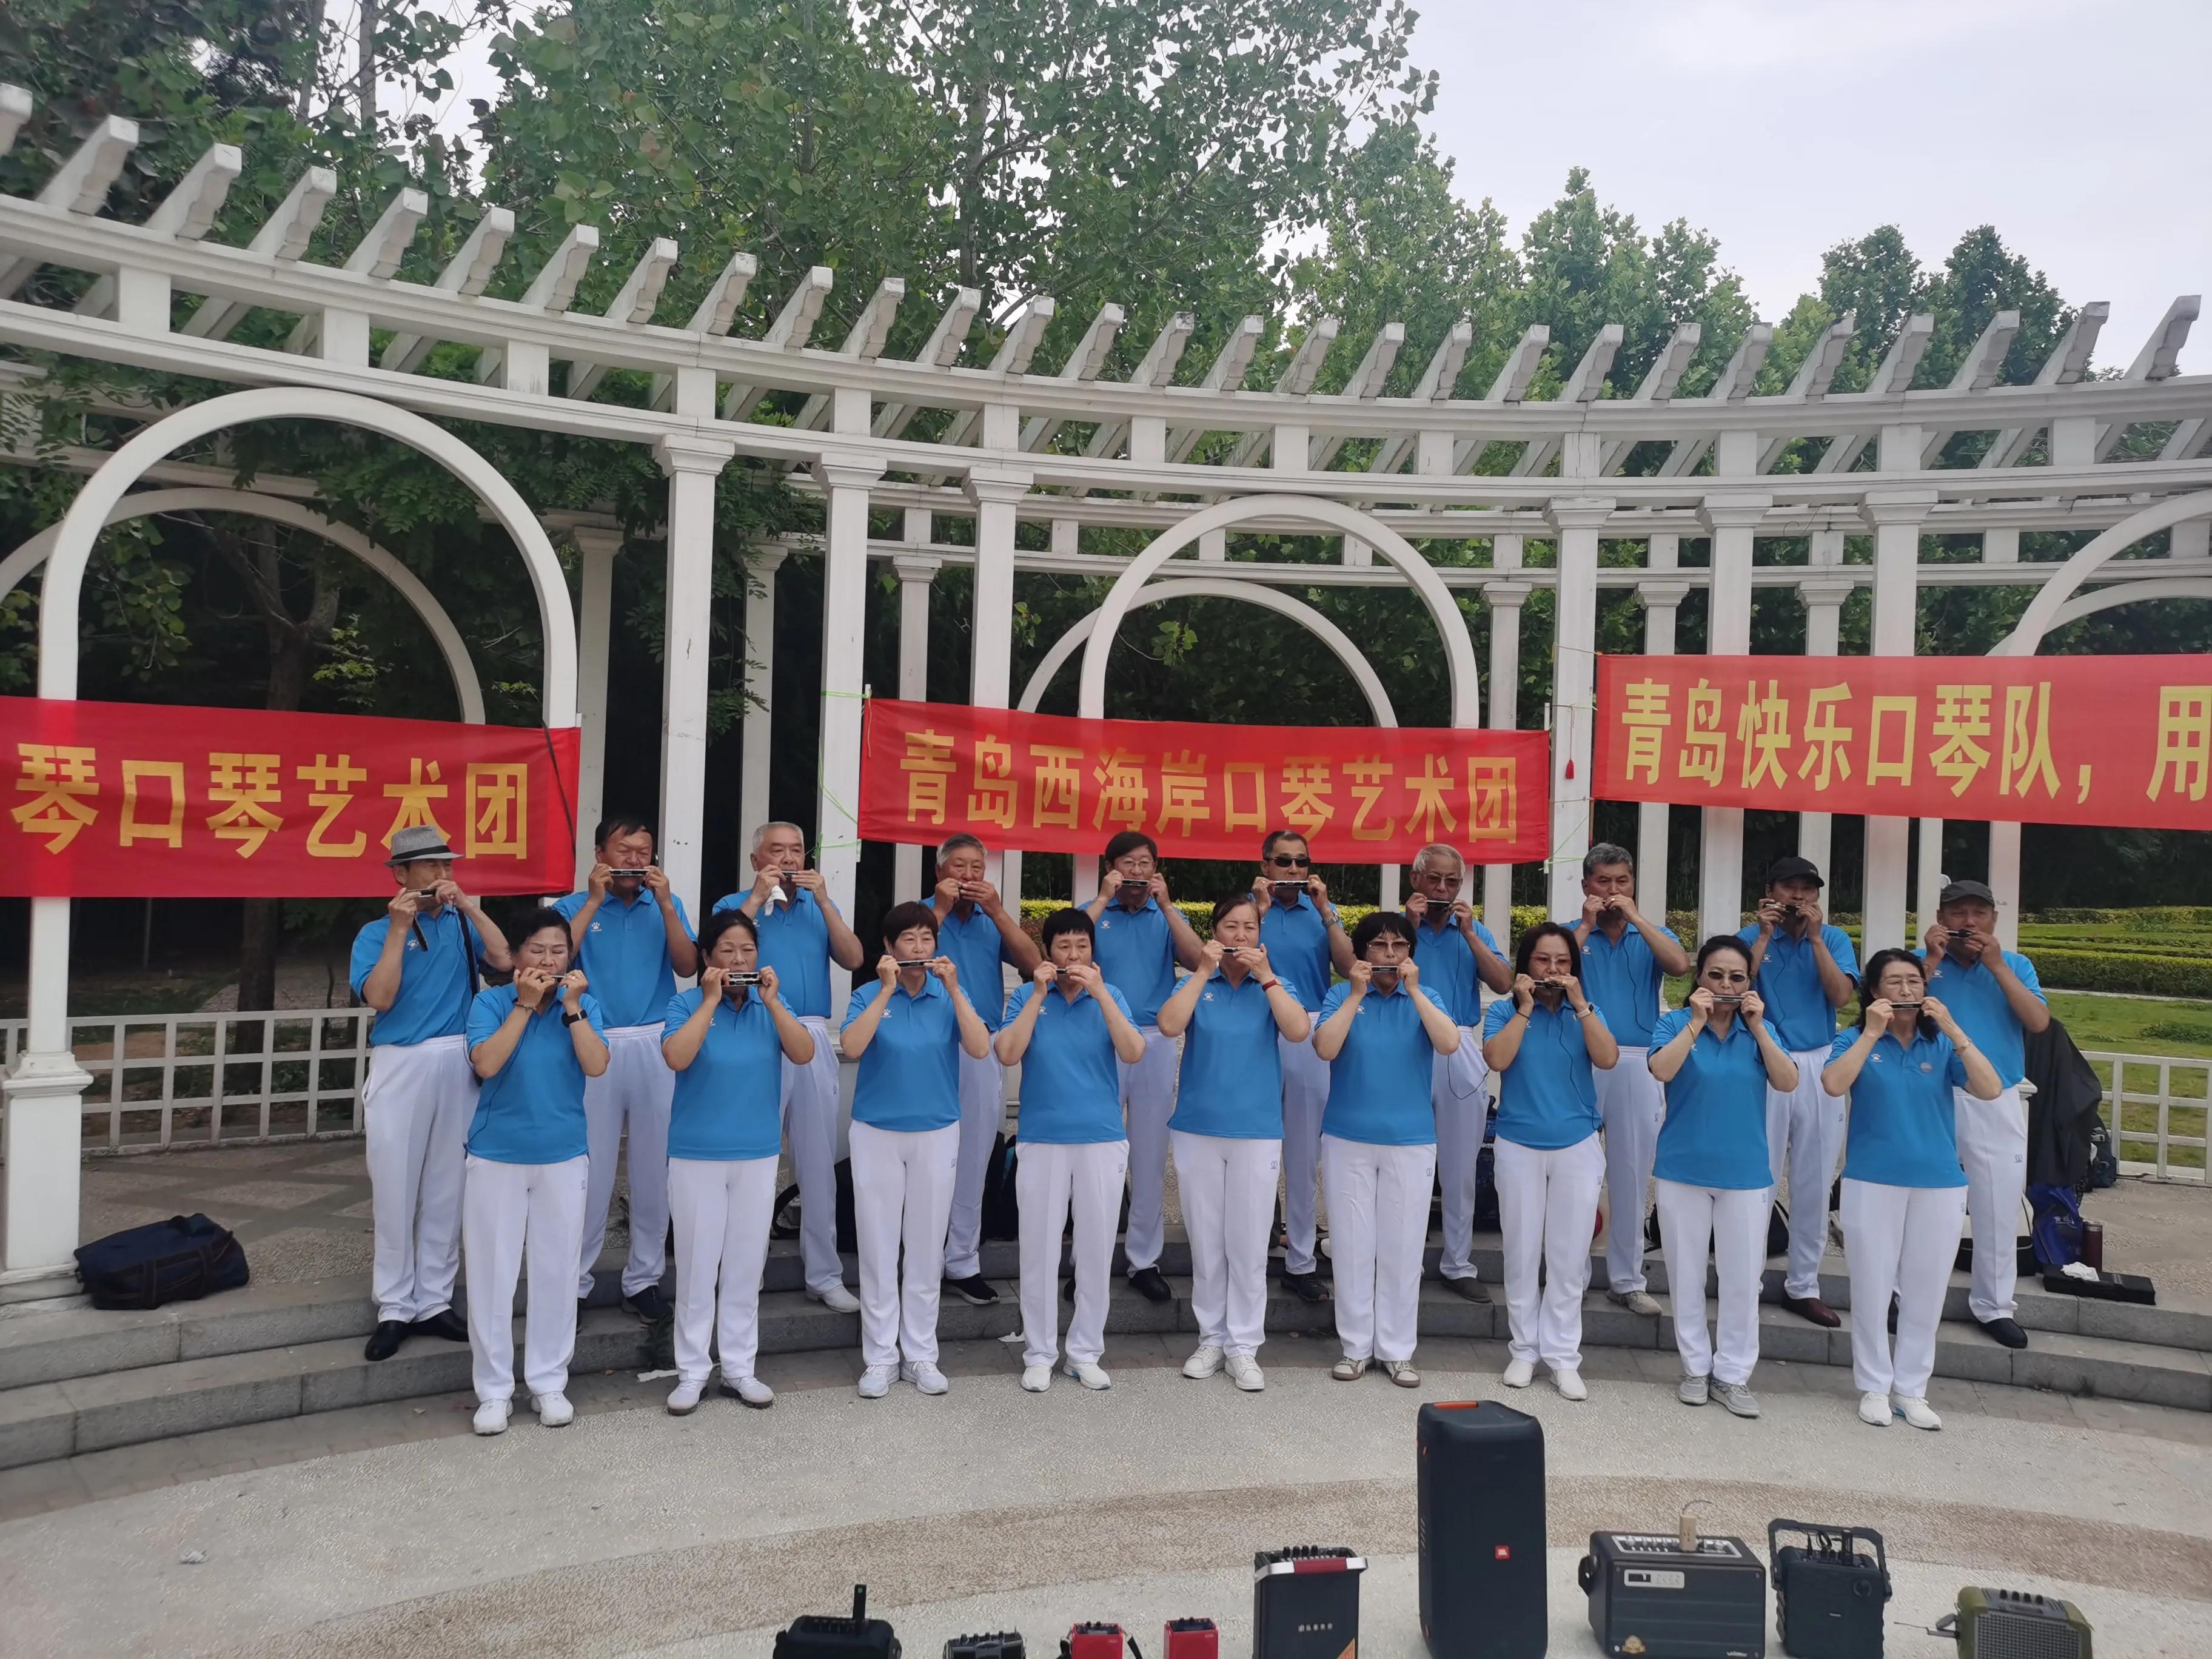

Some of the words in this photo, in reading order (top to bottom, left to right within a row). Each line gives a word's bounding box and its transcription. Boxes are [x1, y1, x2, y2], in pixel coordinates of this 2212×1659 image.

[10, 743, 528, 859] 琴口琴艺术团
[900, 729, 1517, 842] 青岛西海岸口琴艺术团
